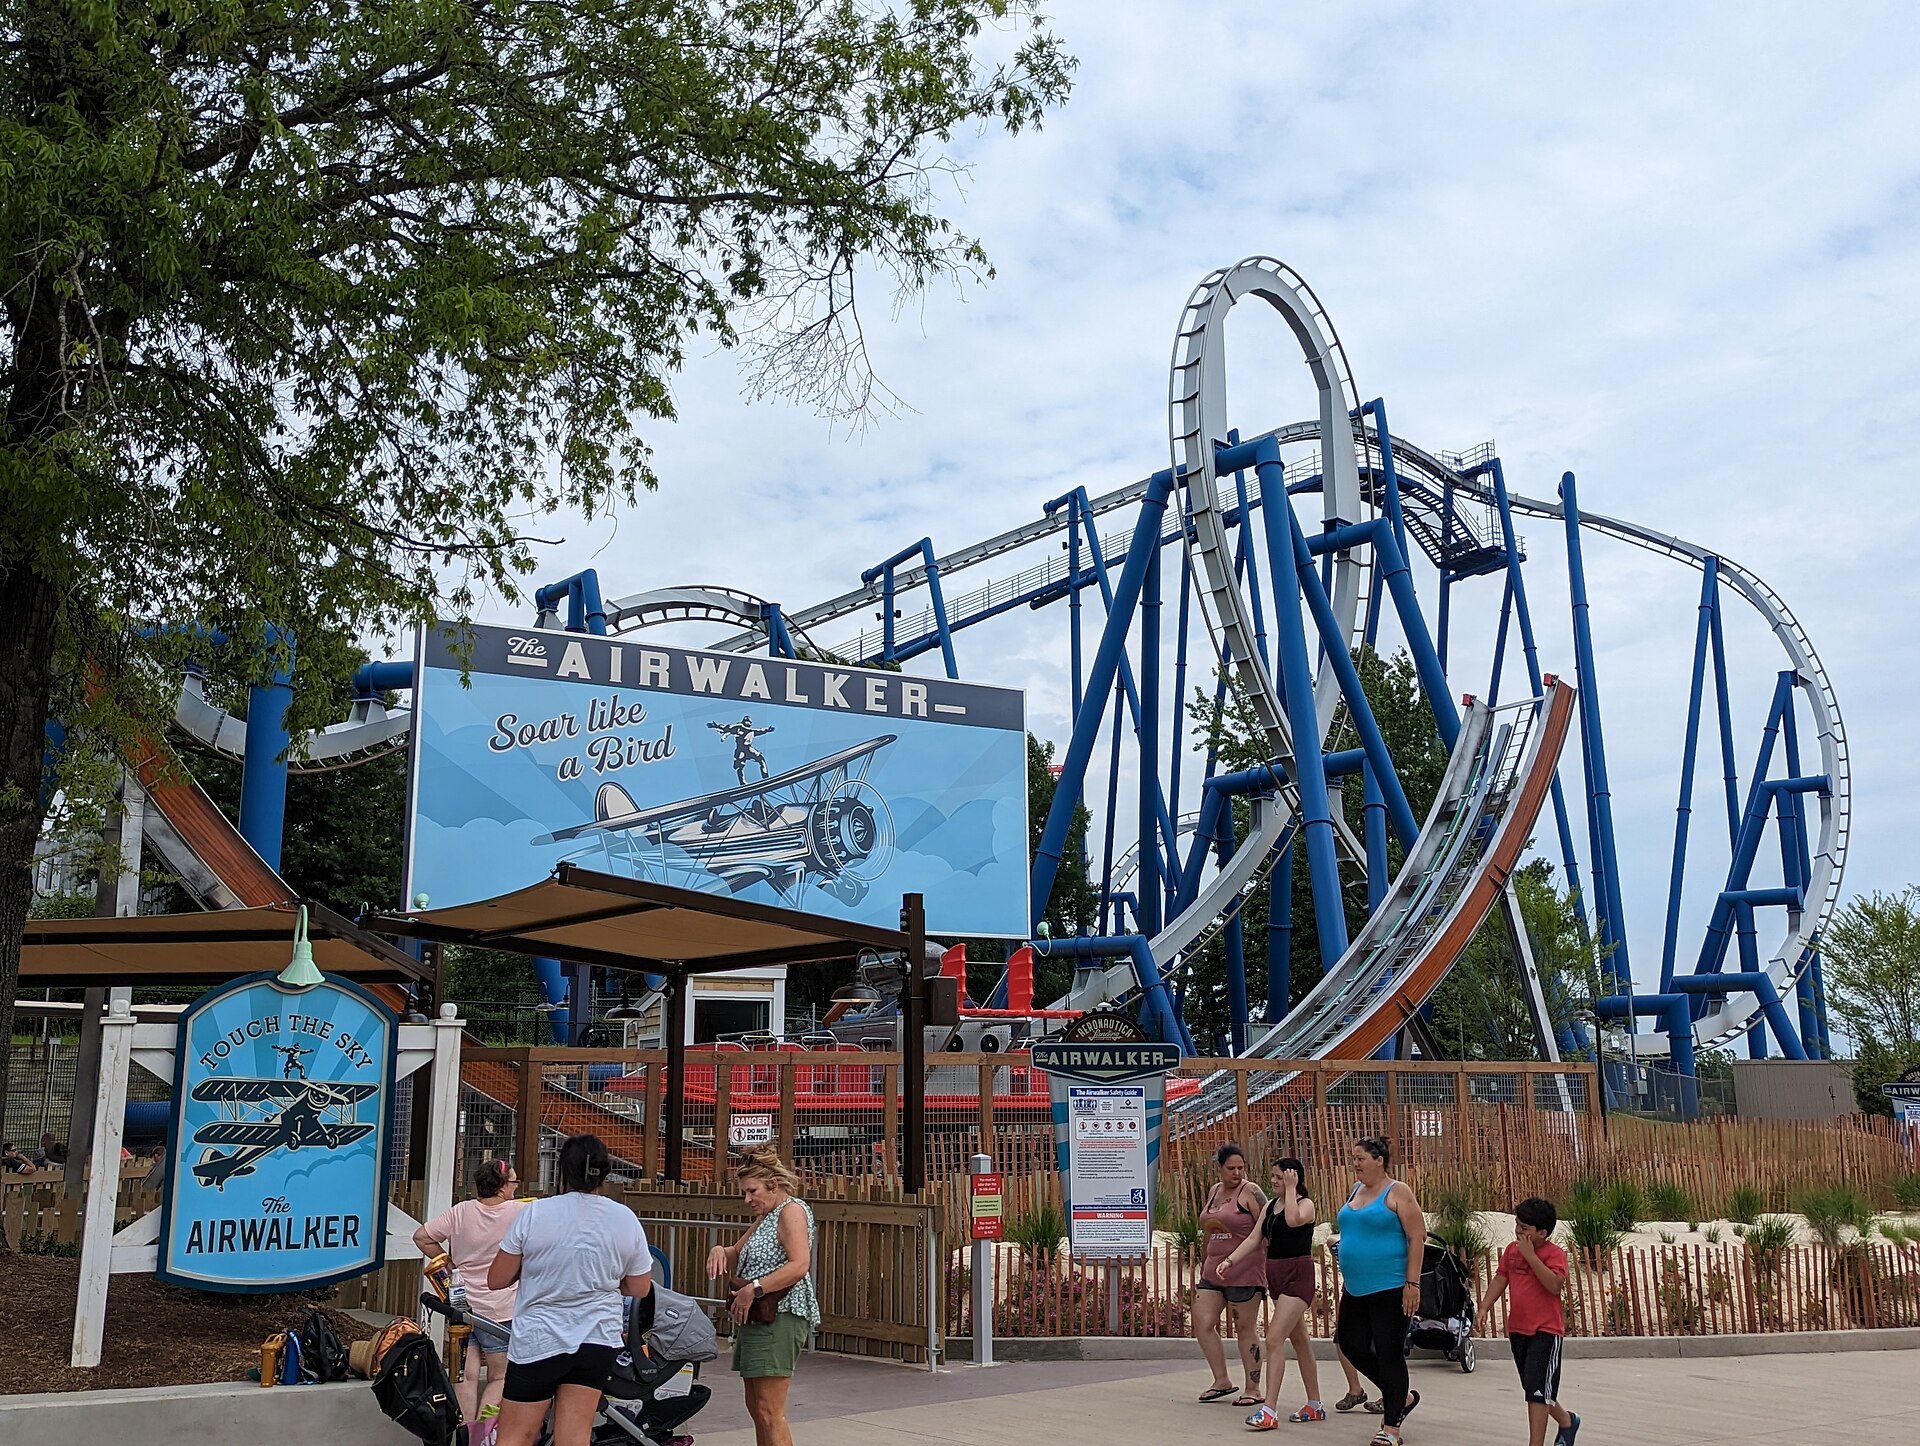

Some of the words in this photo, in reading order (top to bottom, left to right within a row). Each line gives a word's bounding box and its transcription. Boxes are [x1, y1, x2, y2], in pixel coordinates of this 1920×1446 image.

[507, 636, 547, 656] The
[556, 641, 928, 718] AIRWALKER
[488, 712, 581, 752] Soar
[586, 692, 648, 734] like
[557, 754, 584, 781] a
[586, 723, 677, 776] Bird
[199, 1014, 281, 1070] TOUCH
[288, 1014, 335, 1040] THE
[335, 1032, 373, 1070] SKY
[1077, 1018, 1134, 1038] AERONAUTICA
[1034, 1051, 1049, 1059] The
[1047, 1051, 1164, 1065] AIRWALKER
[1110, 1089, 1124, 1097] Safety
[734, 1116, 768, 1125] DANGER
[261, 1195, 292, 1214] The
[184, 1214, 360, 1254] AIRWALKER
